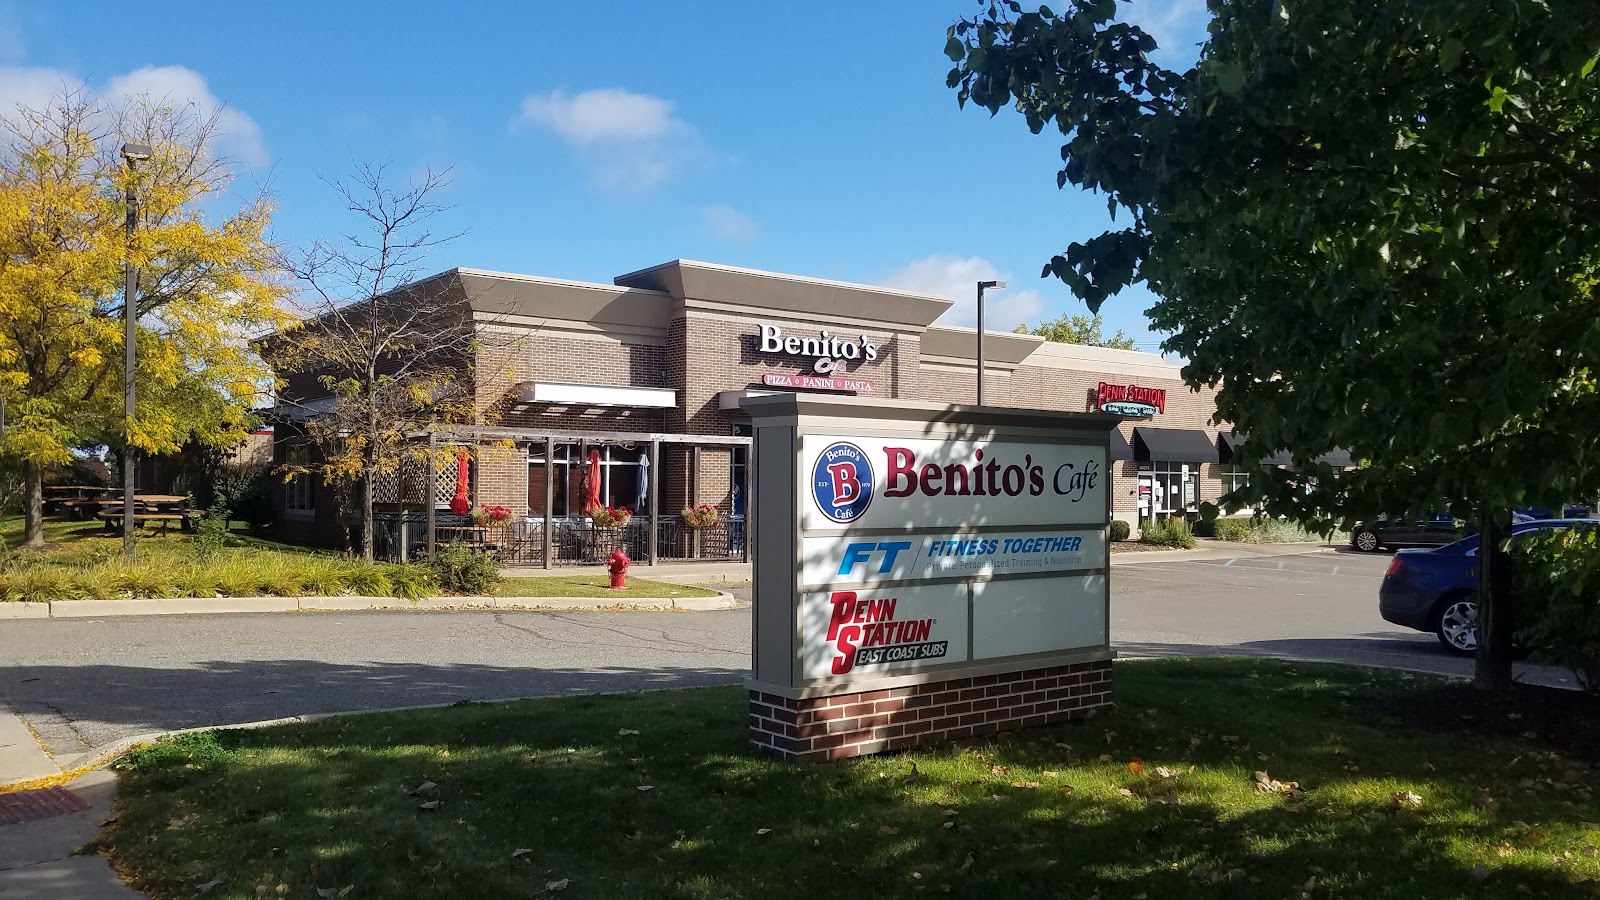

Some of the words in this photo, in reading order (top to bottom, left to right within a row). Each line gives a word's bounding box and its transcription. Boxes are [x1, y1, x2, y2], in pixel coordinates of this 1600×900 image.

[759, 324, 877, 360] Benito's
[767, 374, 792, 386] PIZZA
[803, 377, 834, 388] PANINI
[844, 380, 871, 391] PASTA
[1097, 382, 1126, 409] PENN
[1127, 385, 1166, 414] STATION
[825, 446, 861, 462] Benito's
[827, 461, 861, 508] B
[883, 446, 1044, 498] Benito's
[1053, 460, 1099, 503] Café
[834, 508, 854, 519] Café
[837, 541, 912, 575] FT
[928, 538, 998, 557] FITNESS
[1003, 536, 1082, 554] TOGETHER
[960, 559, 1010, 570] Personalized
[1012, 558, 1043, 567] Training
[1044, 557, 1049, 566] &
[1050, 556, 1082, 565] Nutrition
[826, 591, 897, 641] PENN
[858, 649, 886, 664] EAST
[886, 645, 920, 661] COAST
[921, 642, 946, 658] SUBS
